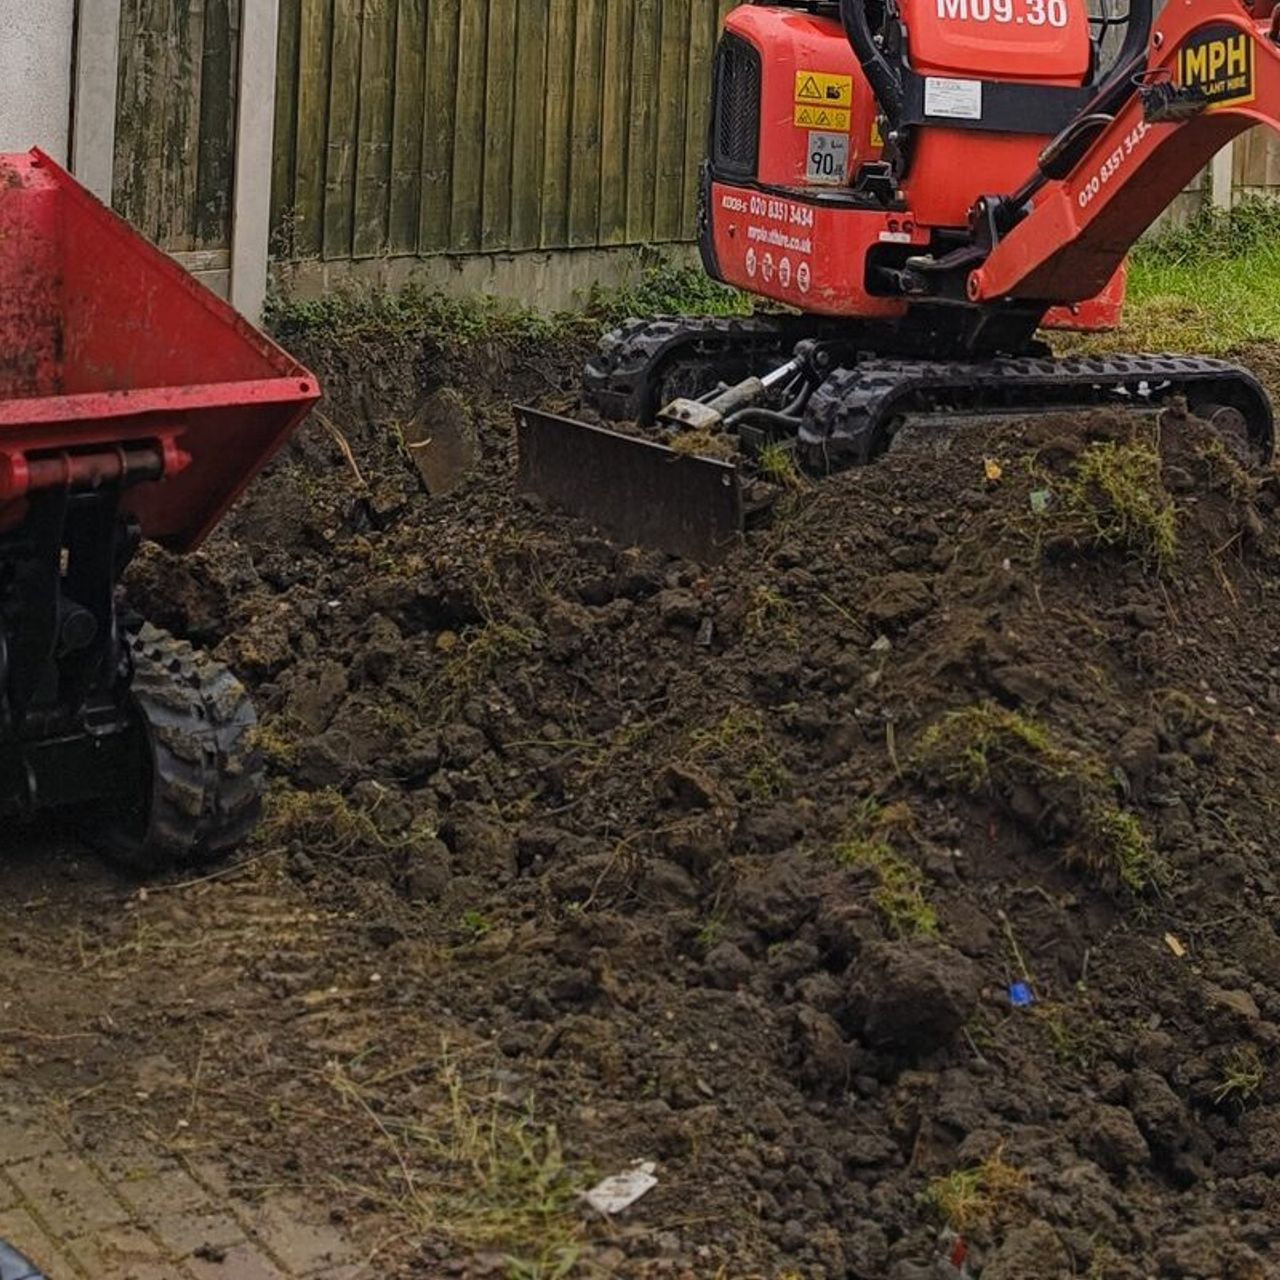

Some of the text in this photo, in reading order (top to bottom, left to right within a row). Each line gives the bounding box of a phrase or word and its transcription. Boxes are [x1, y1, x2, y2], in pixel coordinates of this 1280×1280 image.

[1185, 34, 1247, 87] MPH
[811, 152, 834, 176] 90
[1078, 176, 1101, 208] 020
[1099, 150, 1125, 184] 8351
[749, 196, 768, 217] 020
[768, 199, 789, 222] 8351
[788, 204, 815, 228] 3434
